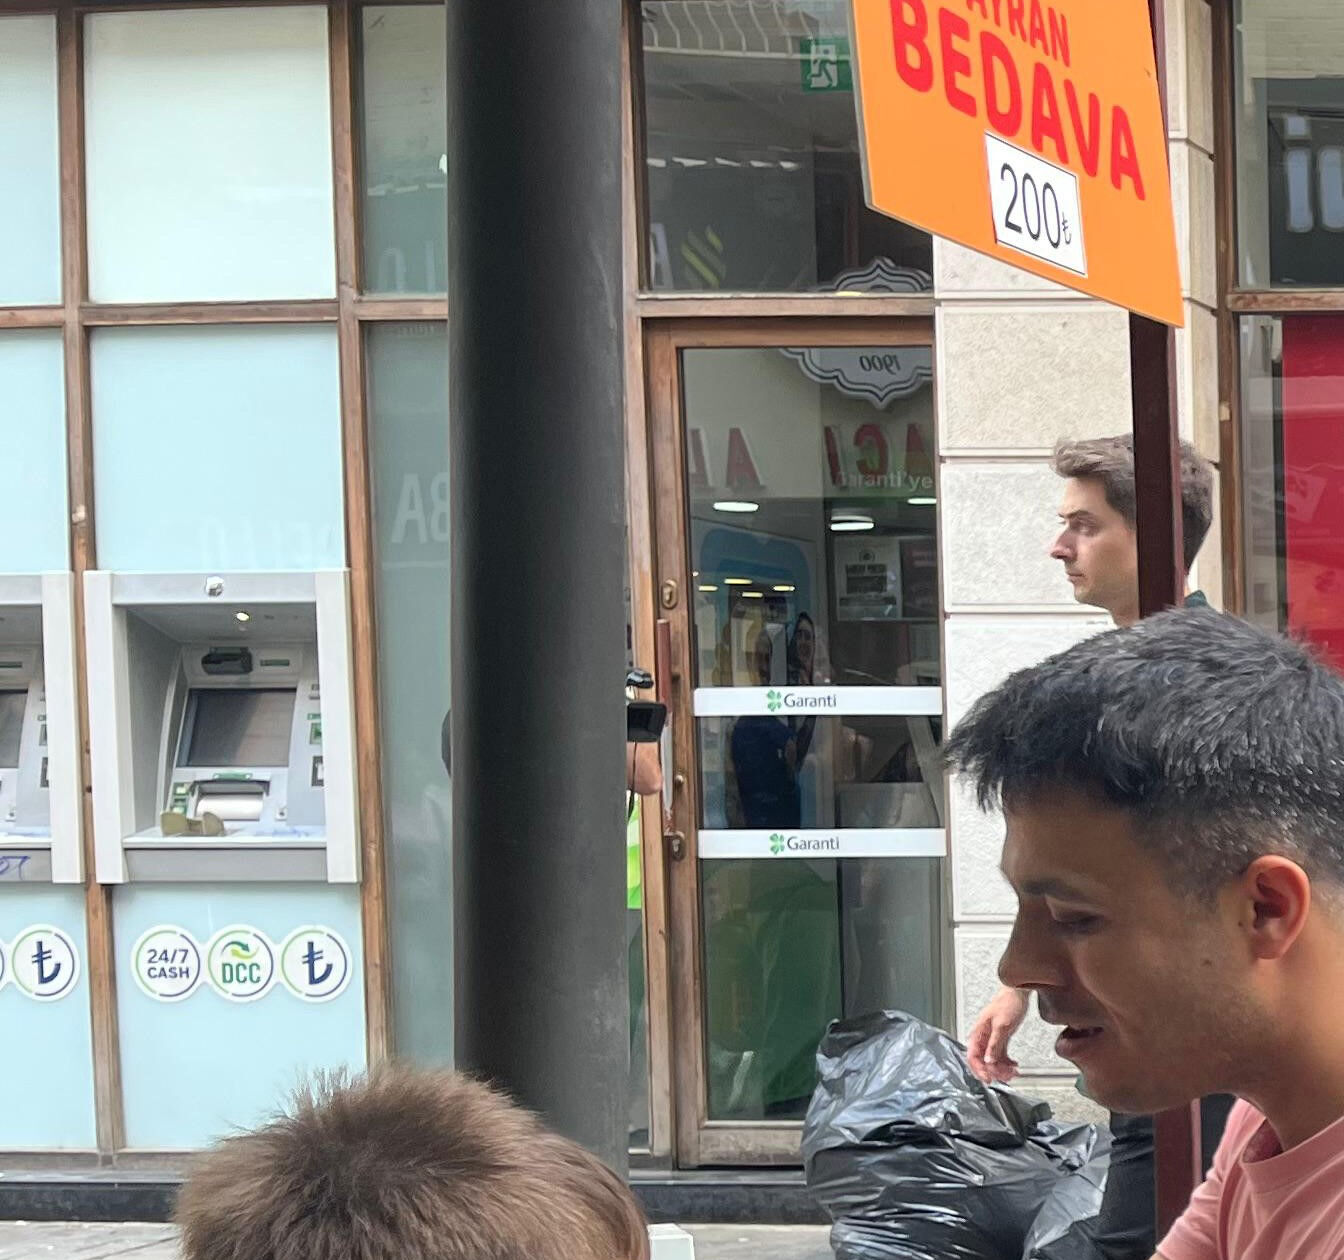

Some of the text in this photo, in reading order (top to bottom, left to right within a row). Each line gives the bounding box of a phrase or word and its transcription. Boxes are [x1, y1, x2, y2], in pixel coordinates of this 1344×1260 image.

[890, 0, 1146, 201] BEDAVA
[783, 692, 837, 709] Garanti
[786, 835, 840, 852] Garanti
[147, 948, 189, 964] 24/7
[147, 967, 190, 979] CASH
[222, 962, 261, 984] DCC
